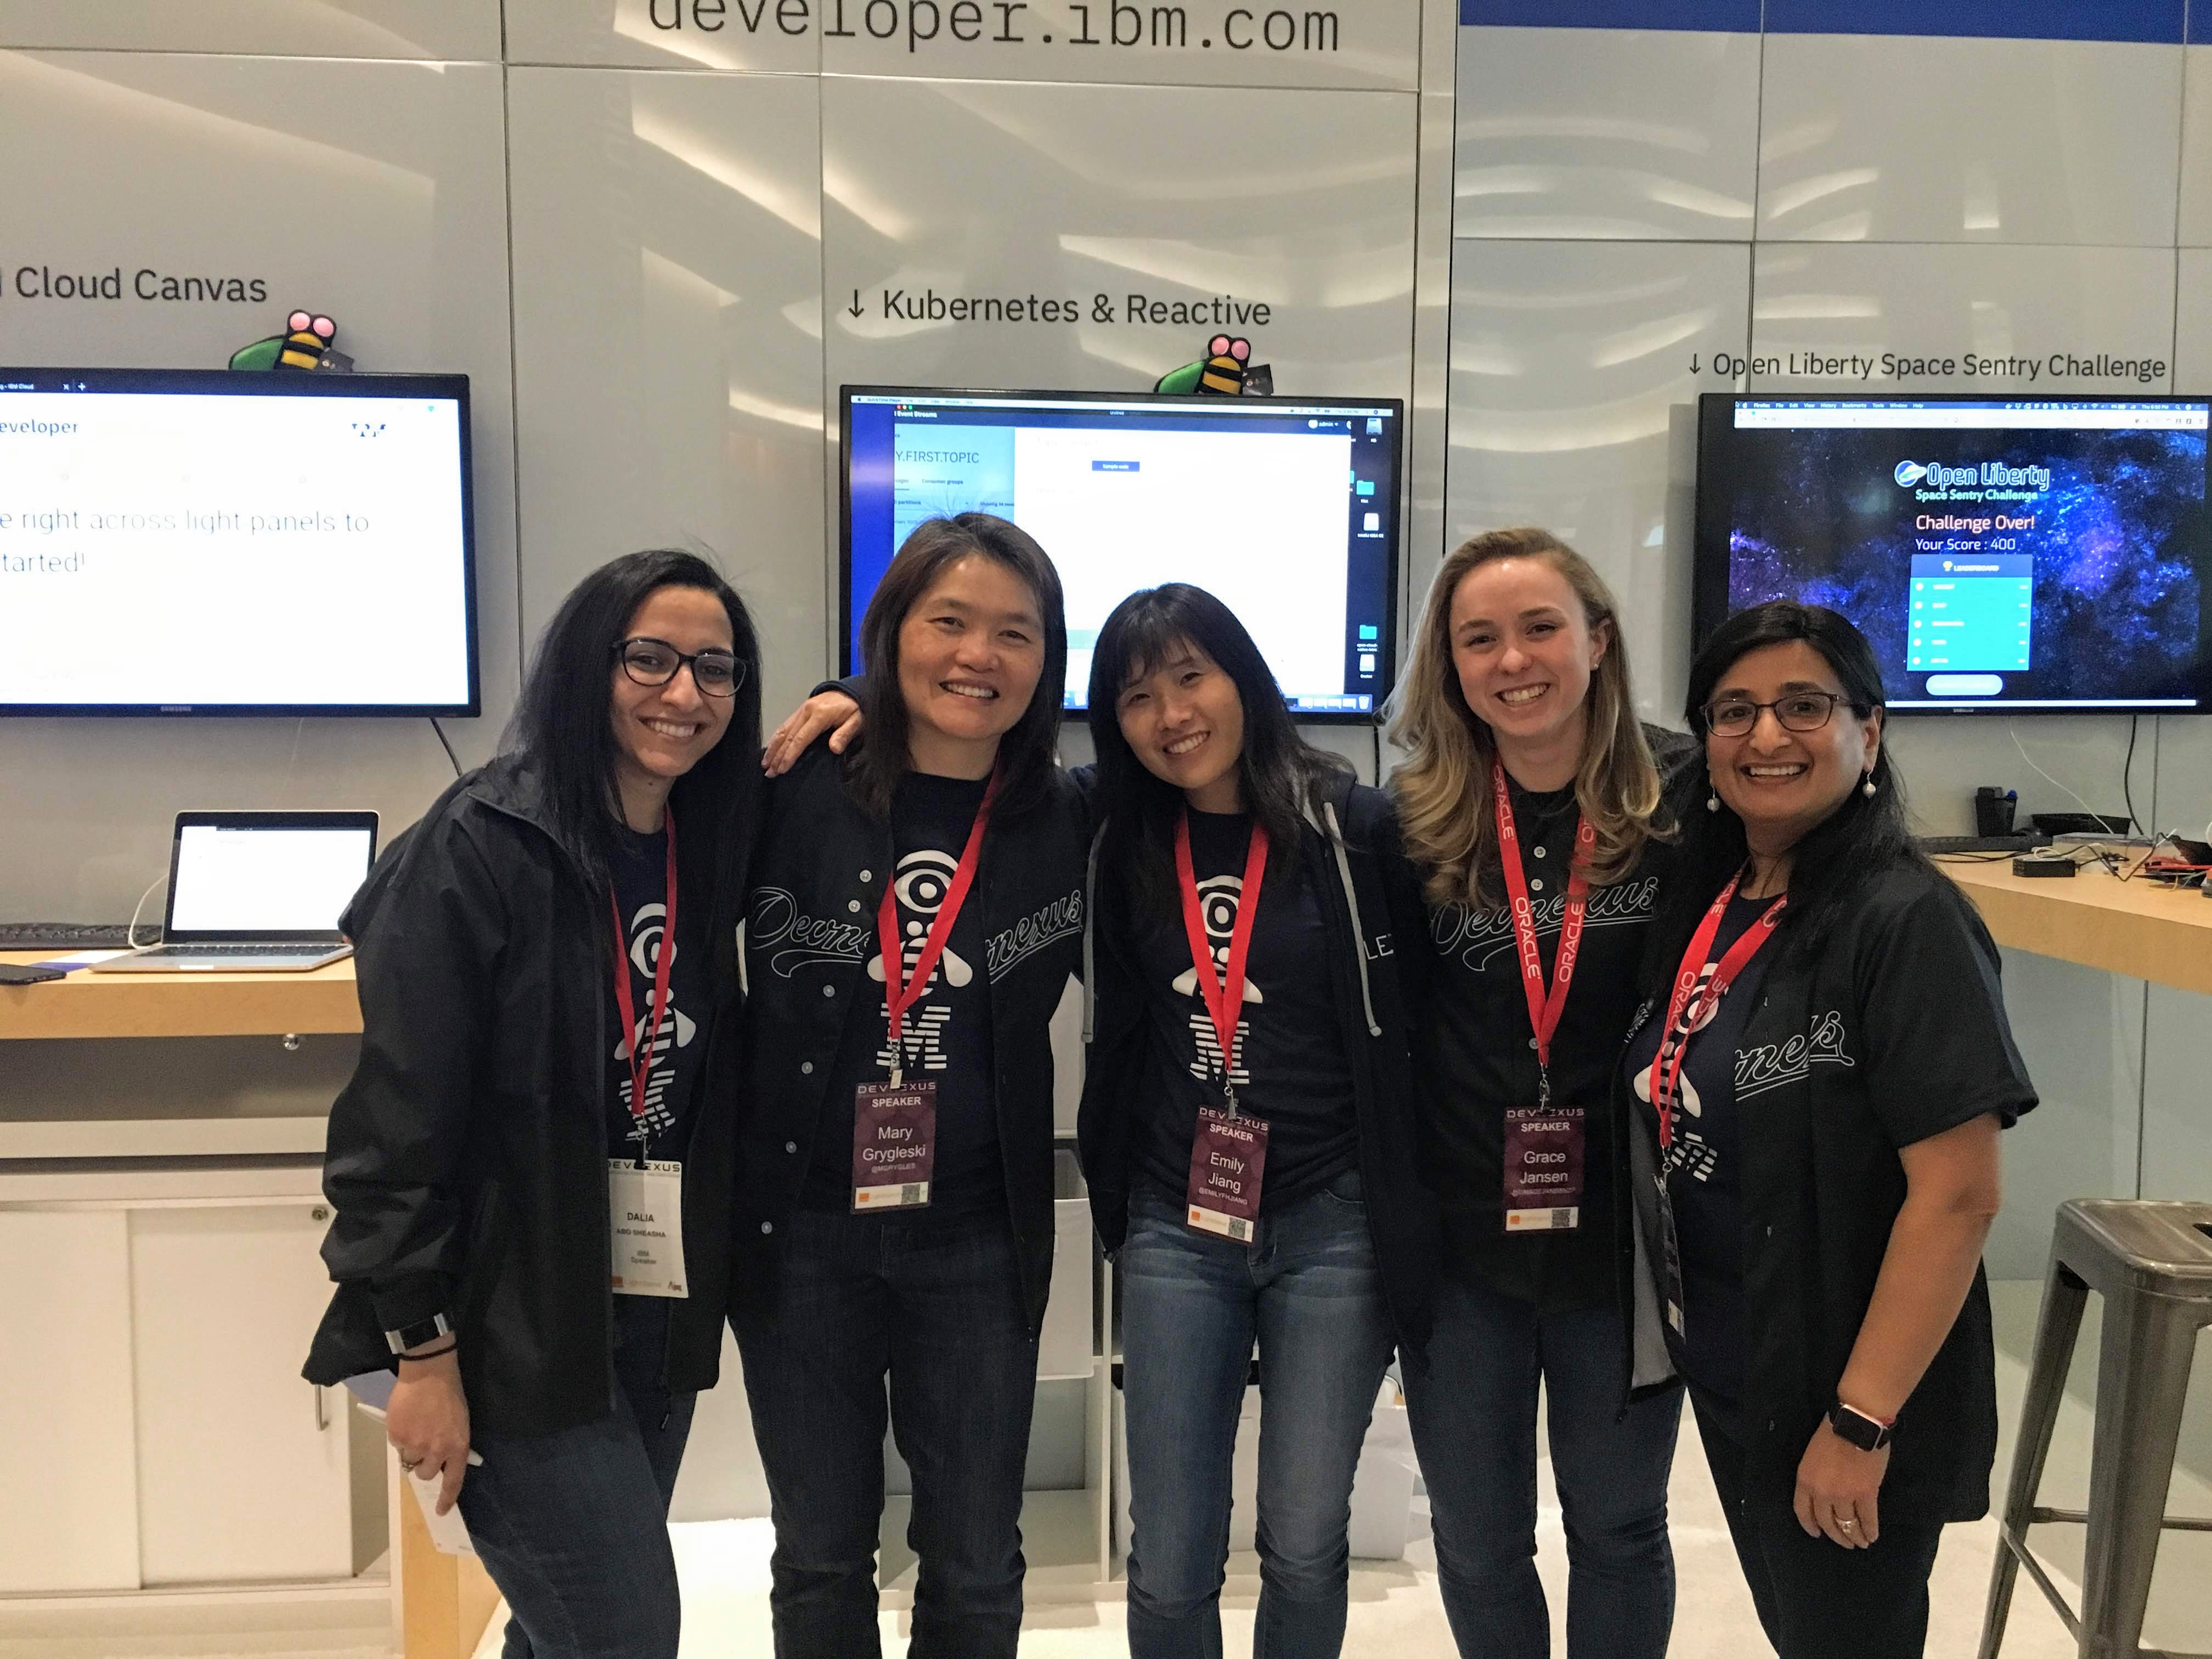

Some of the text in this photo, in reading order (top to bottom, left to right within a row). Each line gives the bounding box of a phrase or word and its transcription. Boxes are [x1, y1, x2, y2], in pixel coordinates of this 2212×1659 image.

[650, 0, 1339, 53] developer.ibm.com
[15, 266, 121, 298] Cloud
[134, 269, 267, 302] Canvas
[884, 289, 1271, 326] Kubernetes & Reactive
[1713, 353, 2166, 381] Open Liberty Space Sentry Challenge
[895, 450, 979, 464] Y.FIRST.TOPIC
[1926, 462, 2050, 492] Open Liberty
[1915, 489, 2038, 503] Space Sentry Challenge
[22, 509, 79, 534] right
[90, 513, 176, 531] across
[187, 510, 240, 535] light
[251, 511, 335, 535] panels
[346, 514, 369, 532] to
[1916, 515, 2035, 534] Challenge Over!
[1915, 538, 1944, 550] Your
[1947, 538, 1981, 550] Score
[1990, 538, 2016, 550] 400
[1493, 765, 1515, 840] ORACLE
[1515, 896, 1541, 980] ORACLE
[1559, 902, 1584, 983] ORACLE
[857, 1082, 936, 1094] DEVEXUS
[872, 1097, 922, 1108] SPEAKER
[1199, 1107, 1268, 1131] DEVEXUS
[1506, 1108, 1584, 1118] DEVEXUS
[878, 1126, 913, 1141] Mary
[1210, 1124, 1254, 1142] SPEAKER
[1521, 1122, 1570, 1132] SPEAKER
[862, 1144, 926, 1163] Grygleski
[1524, 1151, 1566, 1164] Grace
[1210, 1152, 1245, 1175] Emily
[1208, 1172, 1241, 1194] Jiang
[1519, 1172, 1568, 1184] Jansen
[627, 1212, 654, 1223] DALIA
